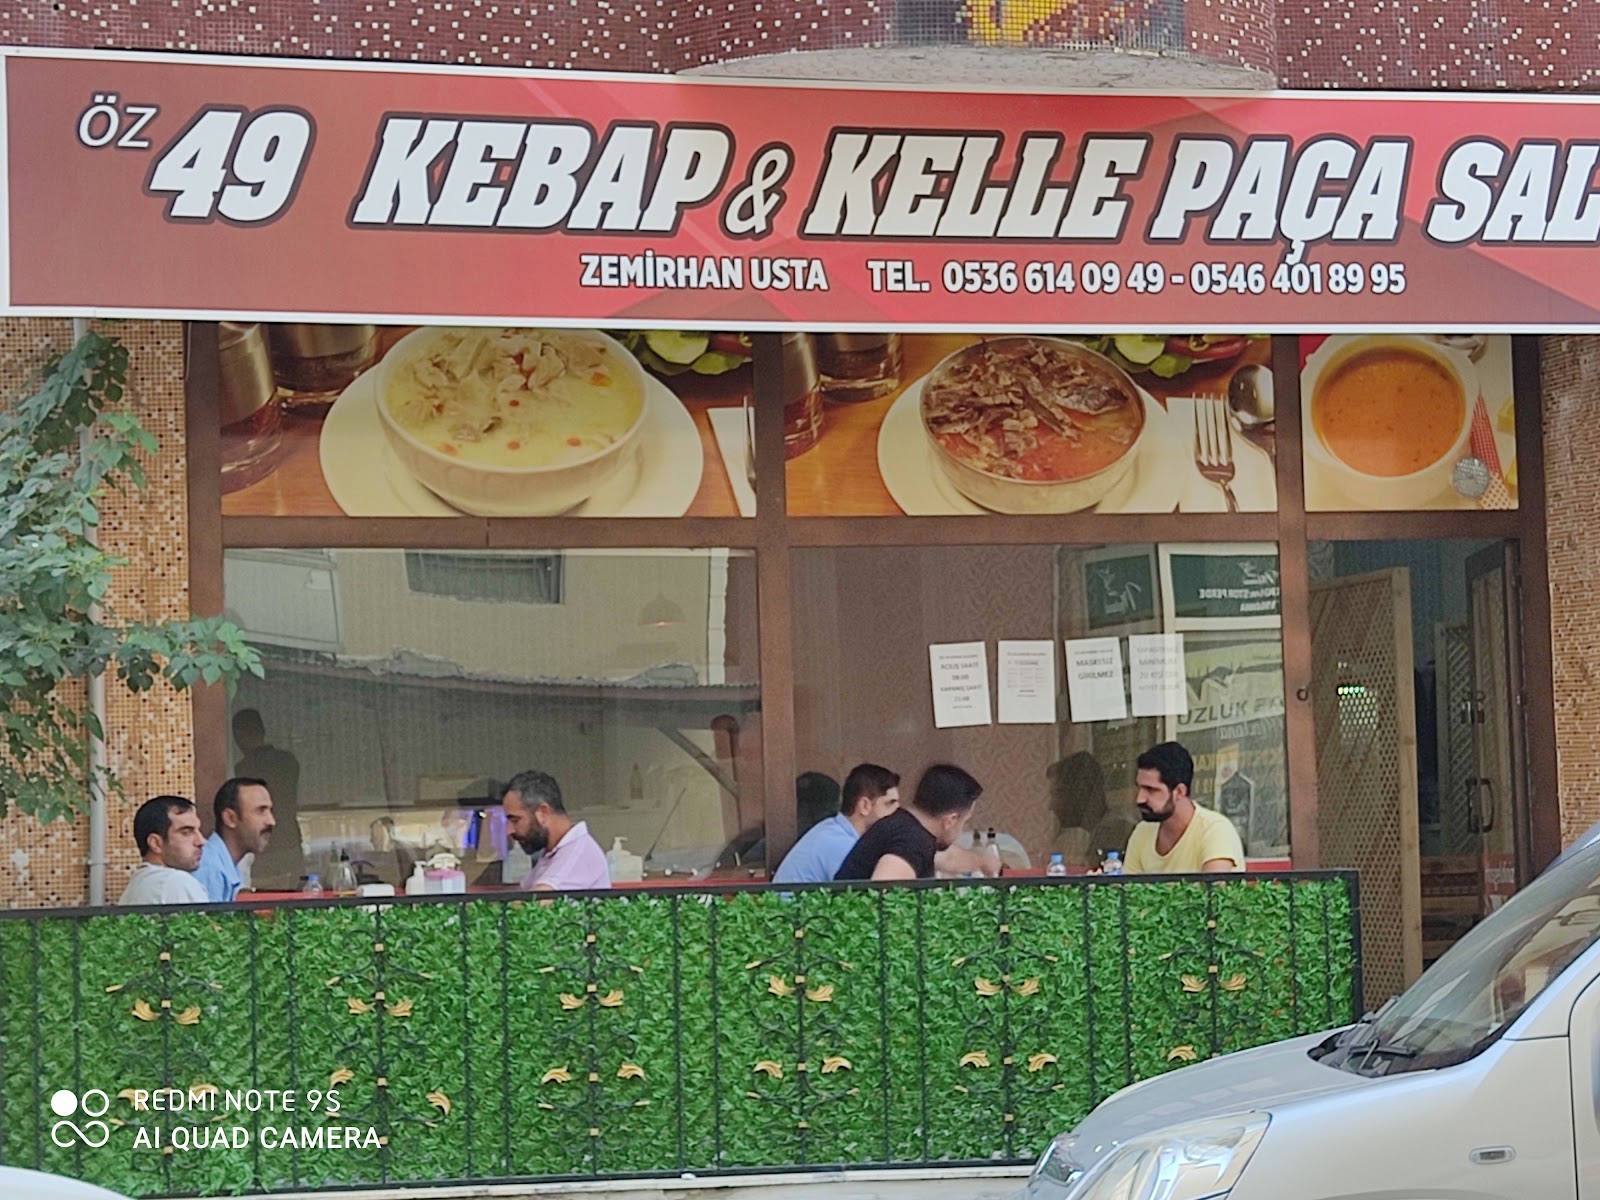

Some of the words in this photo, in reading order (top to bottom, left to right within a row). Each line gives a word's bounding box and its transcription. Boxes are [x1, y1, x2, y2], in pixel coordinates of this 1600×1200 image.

[79, 95, 153, 148] ÖZ
[149, 107, 312, 222] 49
[352, 116, 732, 232] KEBAP
[724, 146, 789, 234] &
[804, 133, 1150, 239] KELLE
[1148, 138, 1410, 264] PAÇA
[581, 250, 743, 289] ZEMİRHAN
[750, 258, 828, 290] USTA
[867, 260, 930, 291] TEL.
[943, 261, 1018, 292] 0536
[1025, 262, 1075, 293] 614
[1081, 262, 1121, 293] 09
[1127, 262, 1164, 293] 49
[1171, 275, 1184, 284] -
[1190, 262, 1267, 295] 0546
[1271, 262, 1323, 294] 401
[1327, 263, 1365, 294] 89
[1370, 263, 1406, 294] 95
